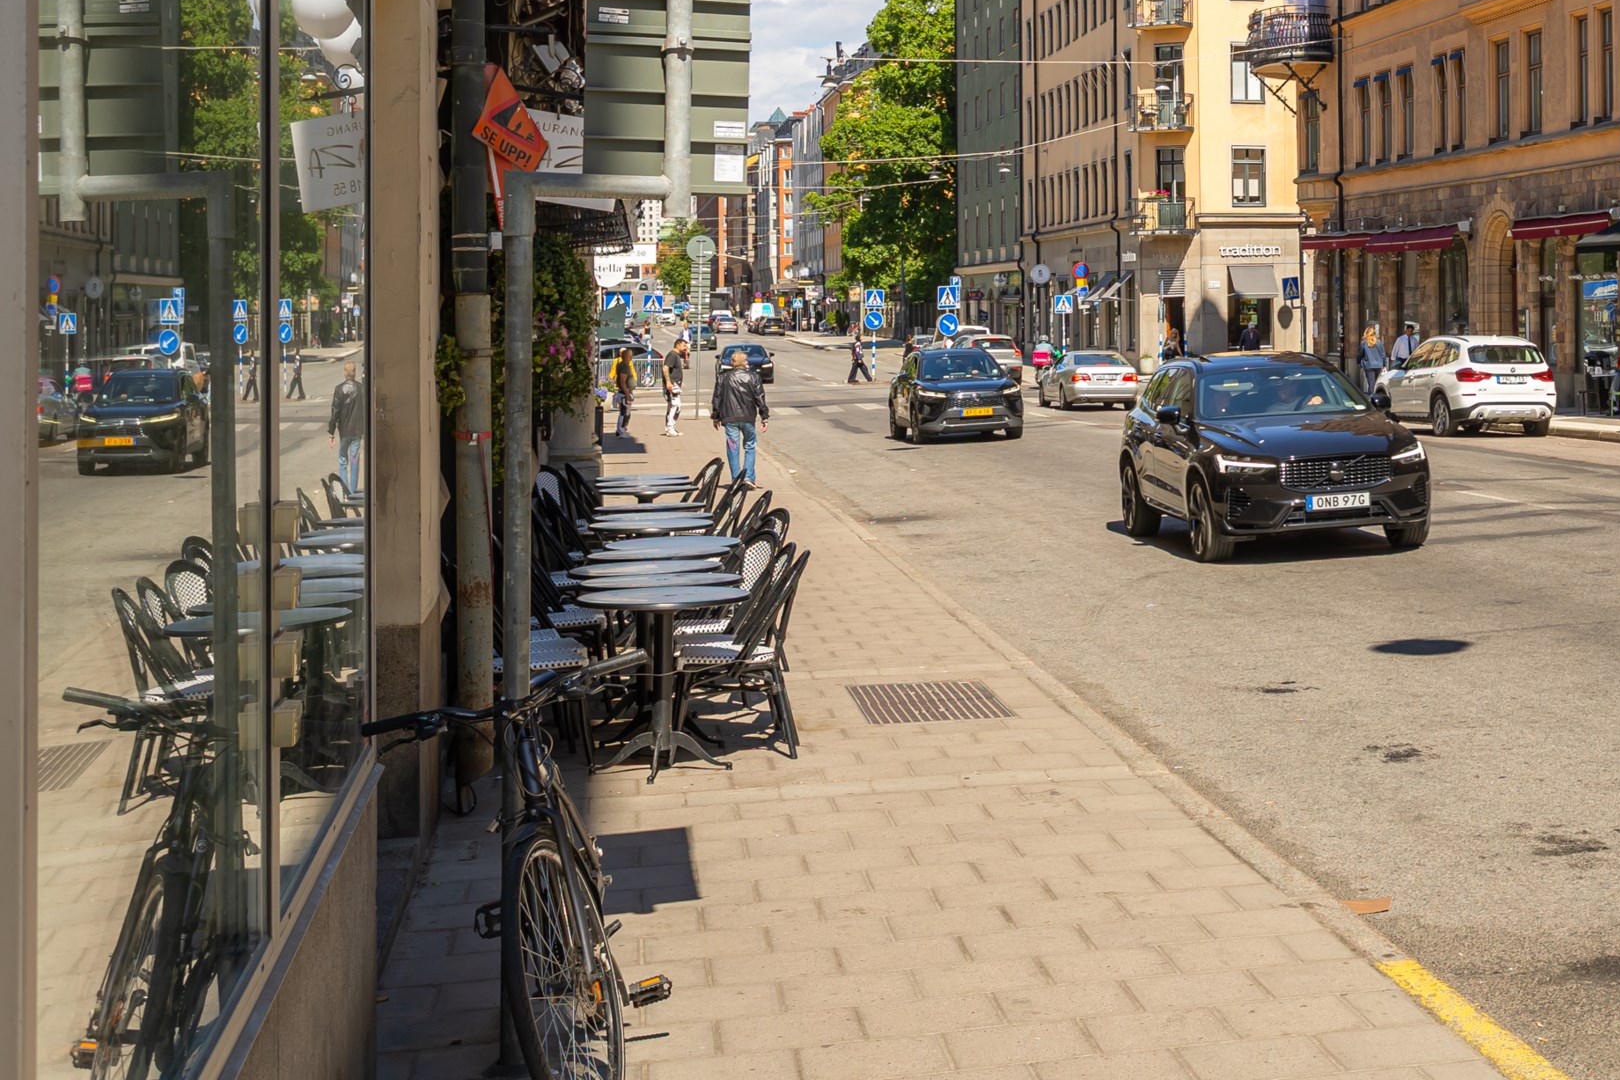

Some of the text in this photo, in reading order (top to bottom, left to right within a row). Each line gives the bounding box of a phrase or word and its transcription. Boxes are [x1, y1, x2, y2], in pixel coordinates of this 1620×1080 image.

[480, 125, 533, 168] SE UPP!
[1219, 244, 1282, 257] tradition
[1316, 494, 1365, 508] ONB 97G
